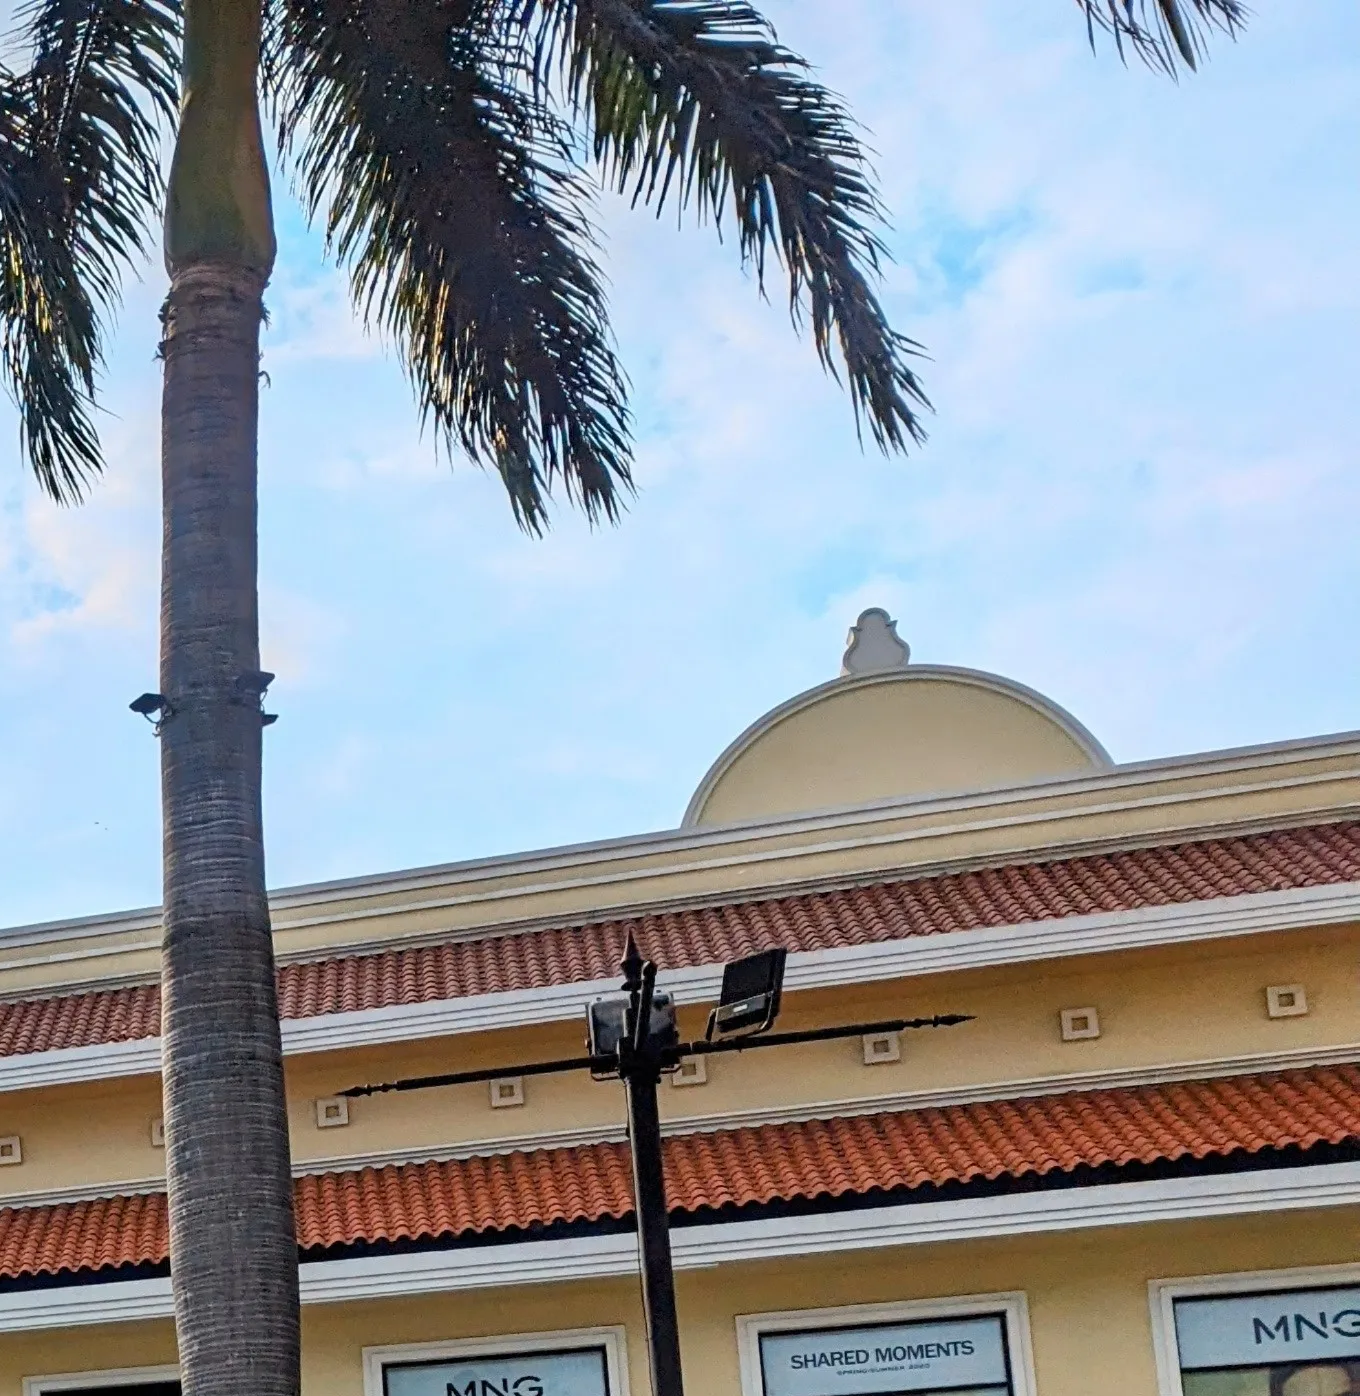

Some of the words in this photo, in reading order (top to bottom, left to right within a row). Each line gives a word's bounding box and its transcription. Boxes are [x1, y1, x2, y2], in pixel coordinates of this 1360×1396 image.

[1252, 1308, 1360, 1345] MNG
[790, 1349, 870, 1370] SHARED
[875, 1340, 975, 1363] MOMENTS
